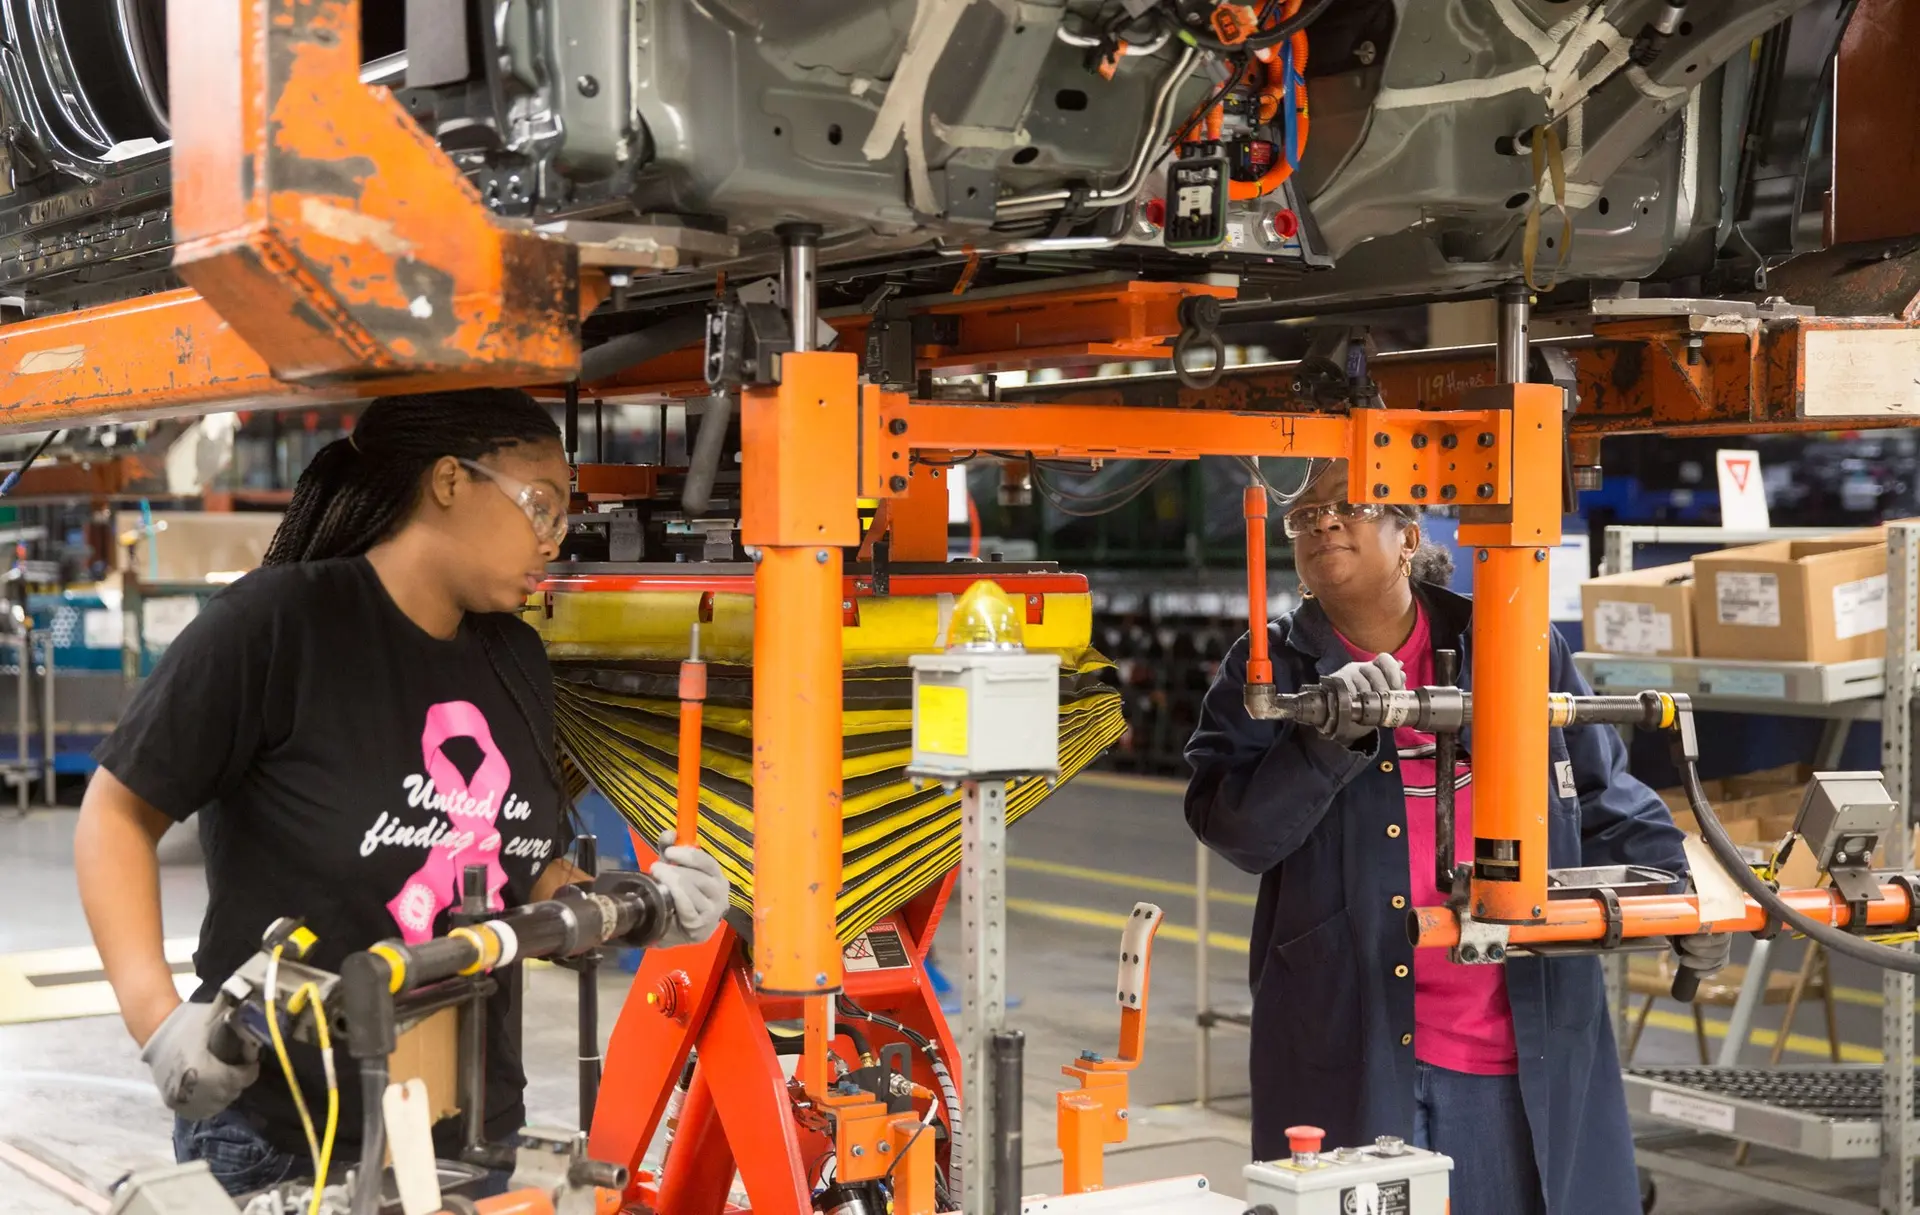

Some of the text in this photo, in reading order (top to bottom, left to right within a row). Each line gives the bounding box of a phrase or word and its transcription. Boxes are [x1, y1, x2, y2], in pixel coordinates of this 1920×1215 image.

[403, 774, 532, 821] United in
[360, 811, 552, 860] finding a cure
